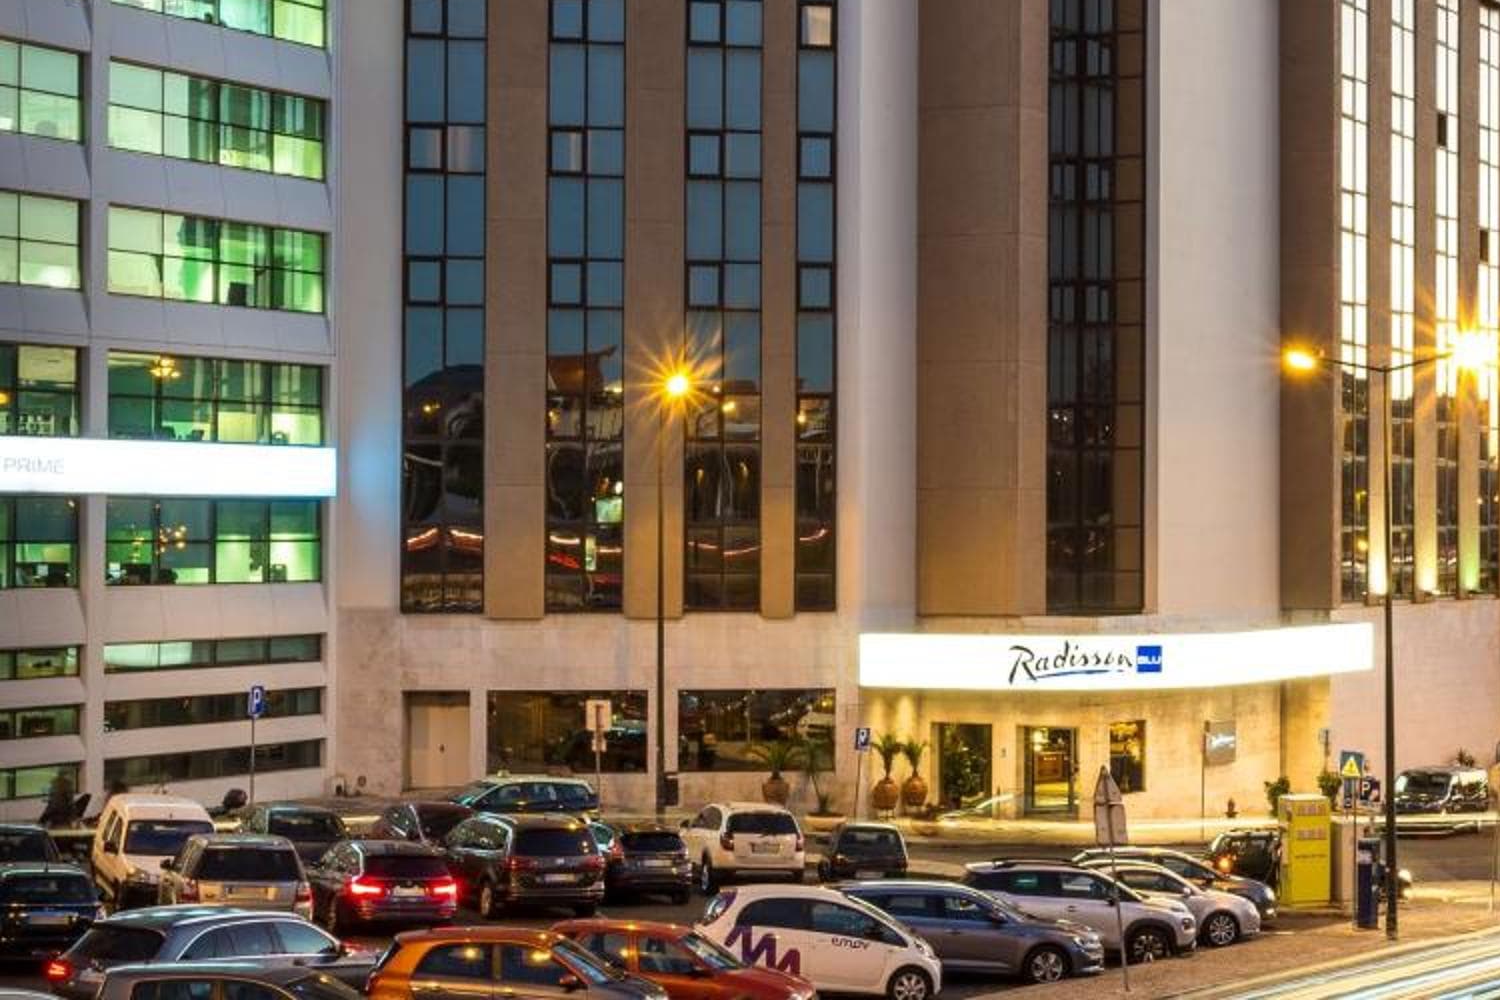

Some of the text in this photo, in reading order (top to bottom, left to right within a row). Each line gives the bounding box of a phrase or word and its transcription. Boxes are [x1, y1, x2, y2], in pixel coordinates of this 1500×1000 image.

[3, 456, 65, 475] PRIME
[1008, 641, 1163, 685] Radisson BLU
[1361, 781, 1371, 798] P
